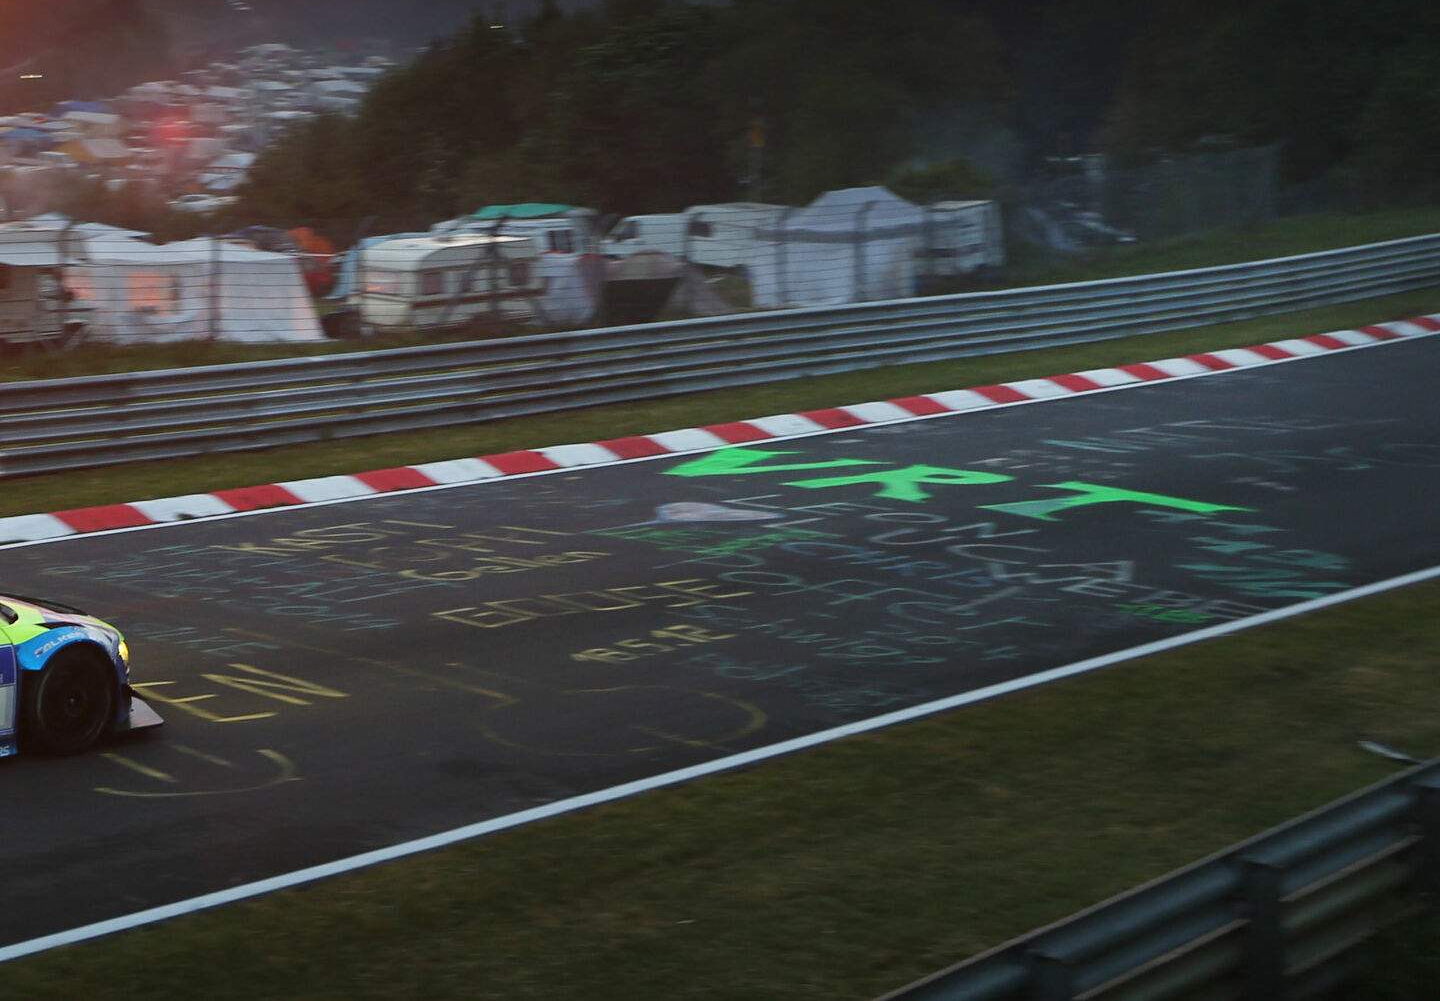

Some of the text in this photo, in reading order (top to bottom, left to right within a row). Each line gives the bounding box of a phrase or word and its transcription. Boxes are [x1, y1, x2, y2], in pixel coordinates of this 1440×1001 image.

[662, 447, 1258, 521] VRT
[720, 494, 1039, 538] LEON
[761, 517, 1134, 583] LUCA
[780, 542, 1039, 587] CHRIS
[432, 579, 754, 628] GOOSE
